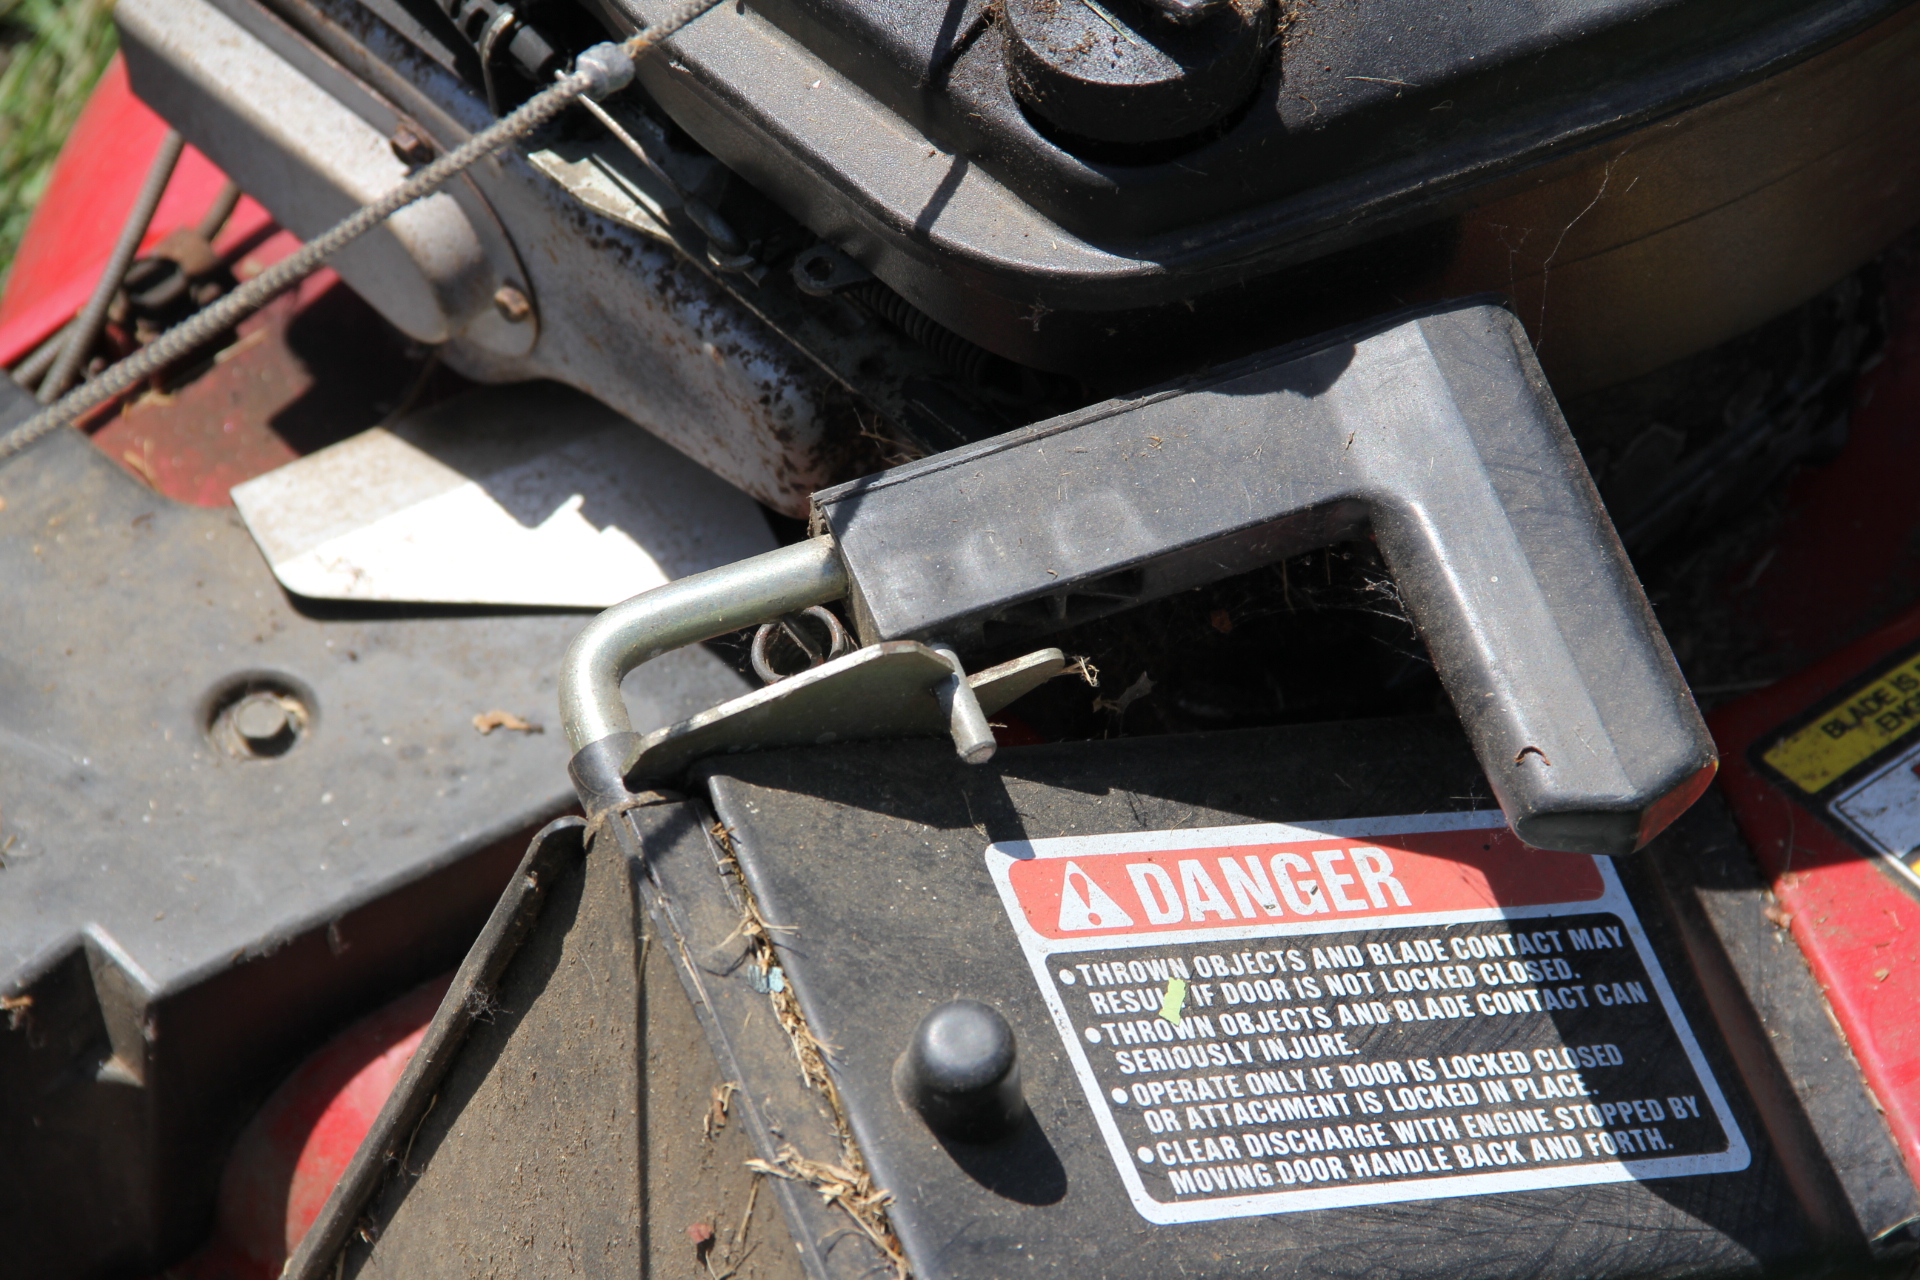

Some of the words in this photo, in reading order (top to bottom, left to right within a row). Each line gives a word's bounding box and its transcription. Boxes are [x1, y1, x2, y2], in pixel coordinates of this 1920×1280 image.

[1822, 687, 1898, 739] BLADE
[1890, 673, 1919, 693] IS
[1875, 691, 1920, 733] ENG
[1125, 847, 1412, 925] DANGER
[1075, 957, 1191, 987] THROWN
[1193, 949, 1307, 979] OBJECTS
[1311, 944, 1365, 970] AND
[1366, 938, 1450, 966] BLADE
[1451, 931, 1564, 960] CONTACT
[1567, 926, 1624, 951] MAY
[1088, 987, 1186, 1015] RESUL
[1190, 983, 1214, 1008] IF
[1220, 978, 1292, 1006] DOOR
[1292, 976, 1322, 999] IS
[1324, 971, 1375, 997] NOT
[1379, 965, 1477, 993] LOCKED
[1479, 958, 1581, 986] CLOSED.
[1100, 1014, 1217, 1046] THROWN
[1219, 1006, 1333, 1037] OBJECTS
[1337, 1001, 1390, 1027] AND
[1392, 994, 1476, 1023] BLADE
[1476, 985, 1590, 1016] CONTACT
[1594, 981, 1649, 1006] CAN
[1115, 1041, 1254, 1075] SERIOUSLY
[1258, 1032, 1361, 1062] INJURE.
[1131, 1074, 1245, 1107] OPERATE
[1245, 1068, 1307, 1096] ONLY
[1311, 1066, 1334, 1090] IF
[1339, 1061, 1409, 1088] DOOR
[1407, 1058, 1437, 1082] IS
[1437, 1051, 1531, 1080] LOCKED
[1533, 1044, 1624, 1072] CLOSED
[1143, 1108, 1183, 1134] OR
[1185, 1093, 1351, 1130] ATTACHMENT
[1354, 1090, 1384, 1114] IS
[1384, 1082, 1479, 1112] LOCKED
[1480, 1080, 1511, 1104] IN
[1511, 1073, 1599, 1101] PLACE.
[1155, 1135, 1242, 1166] CLEAR
[1242, 1122, 1391, 1158] DISCHARGE
[1389, 1116, 1461, 1145] WITH
[1461, 1108, 1555, 1138] ENGINE
[1554, 1099, 1666, 1131] STOPPED
[1666, 1095, 1700, 1119] BY
[1167, 1162, 1274, 1195] MOVING
[1275, 1155, 1348, 1185] DOOR
[1349, 1146, 1454, 1178] HANDLE
[1453, 1140, 1528, 1169] BACK
[1530, 1134, 1584, 1162] AND
[1584, 1127, 1675, 1157] FORTH.
